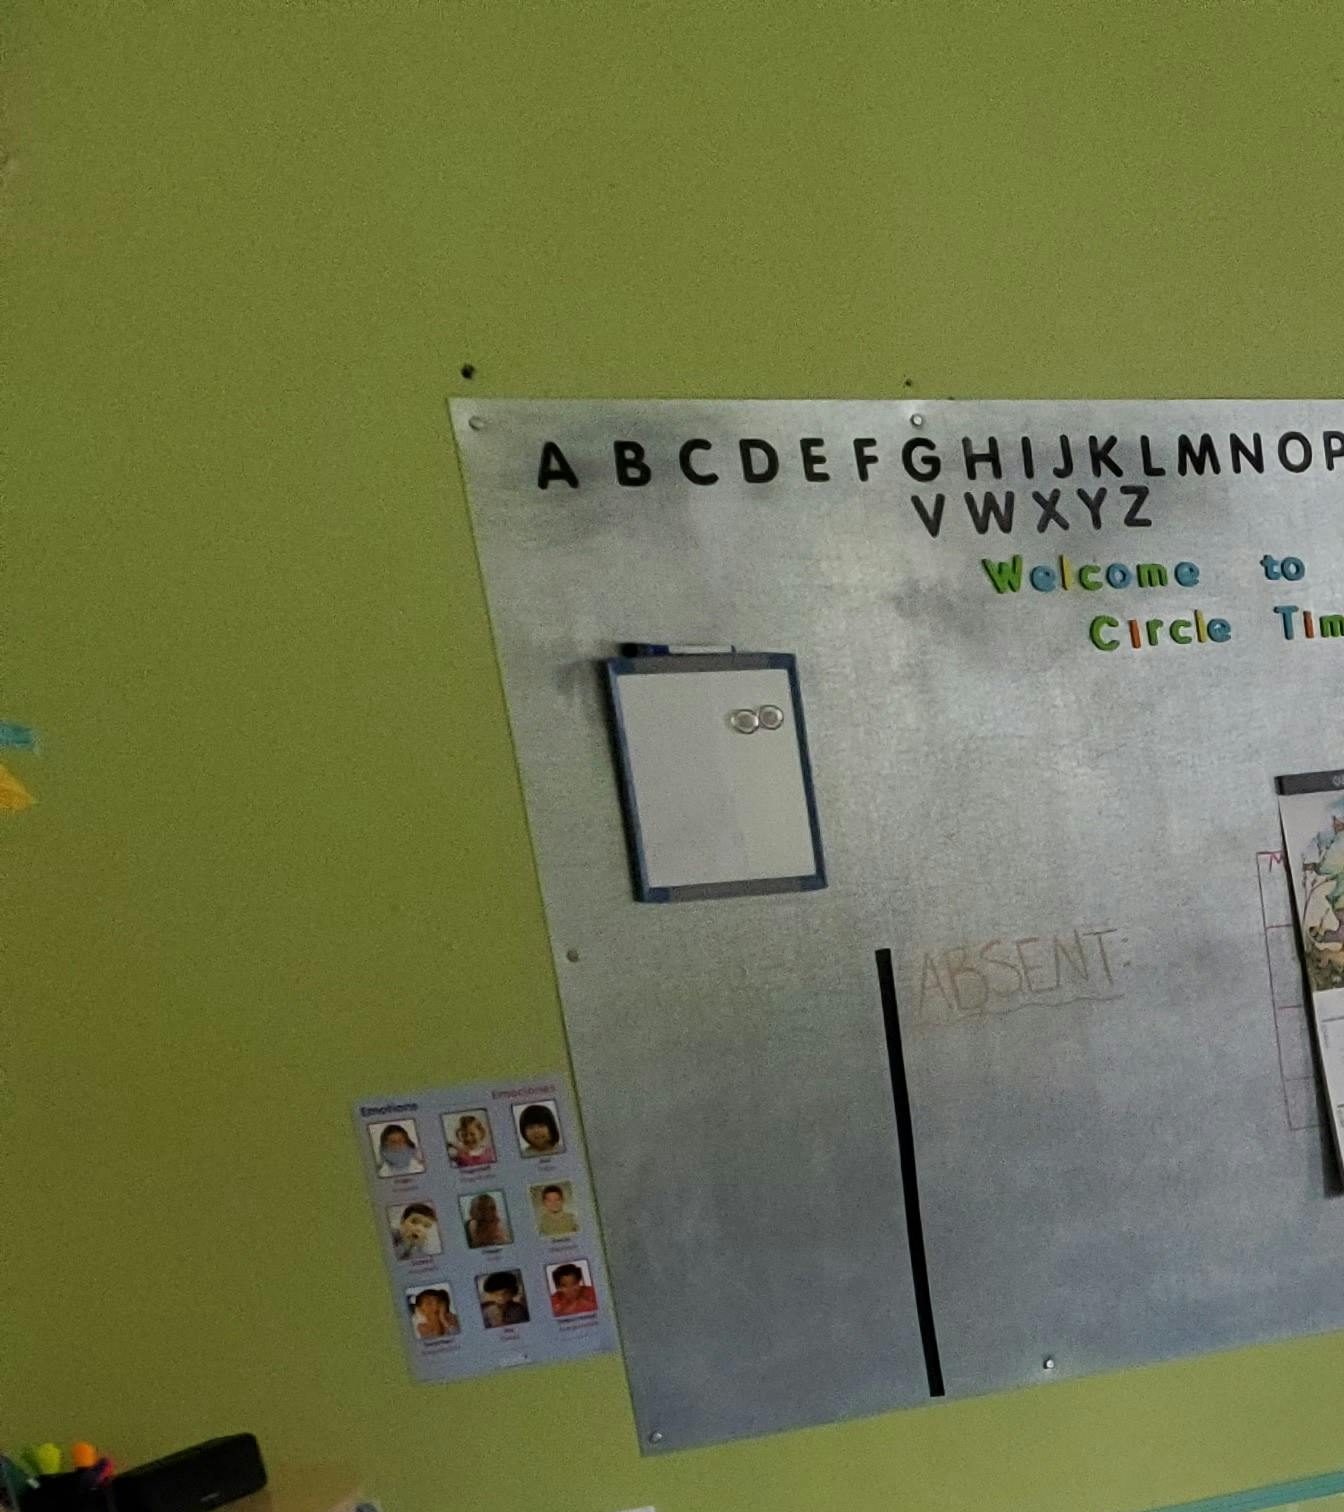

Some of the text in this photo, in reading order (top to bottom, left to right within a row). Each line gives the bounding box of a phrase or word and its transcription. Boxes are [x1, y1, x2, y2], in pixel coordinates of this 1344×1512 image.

[982, 554, 1306, 593] Welcome to
[1089, 609, 1232, 651] Circle
